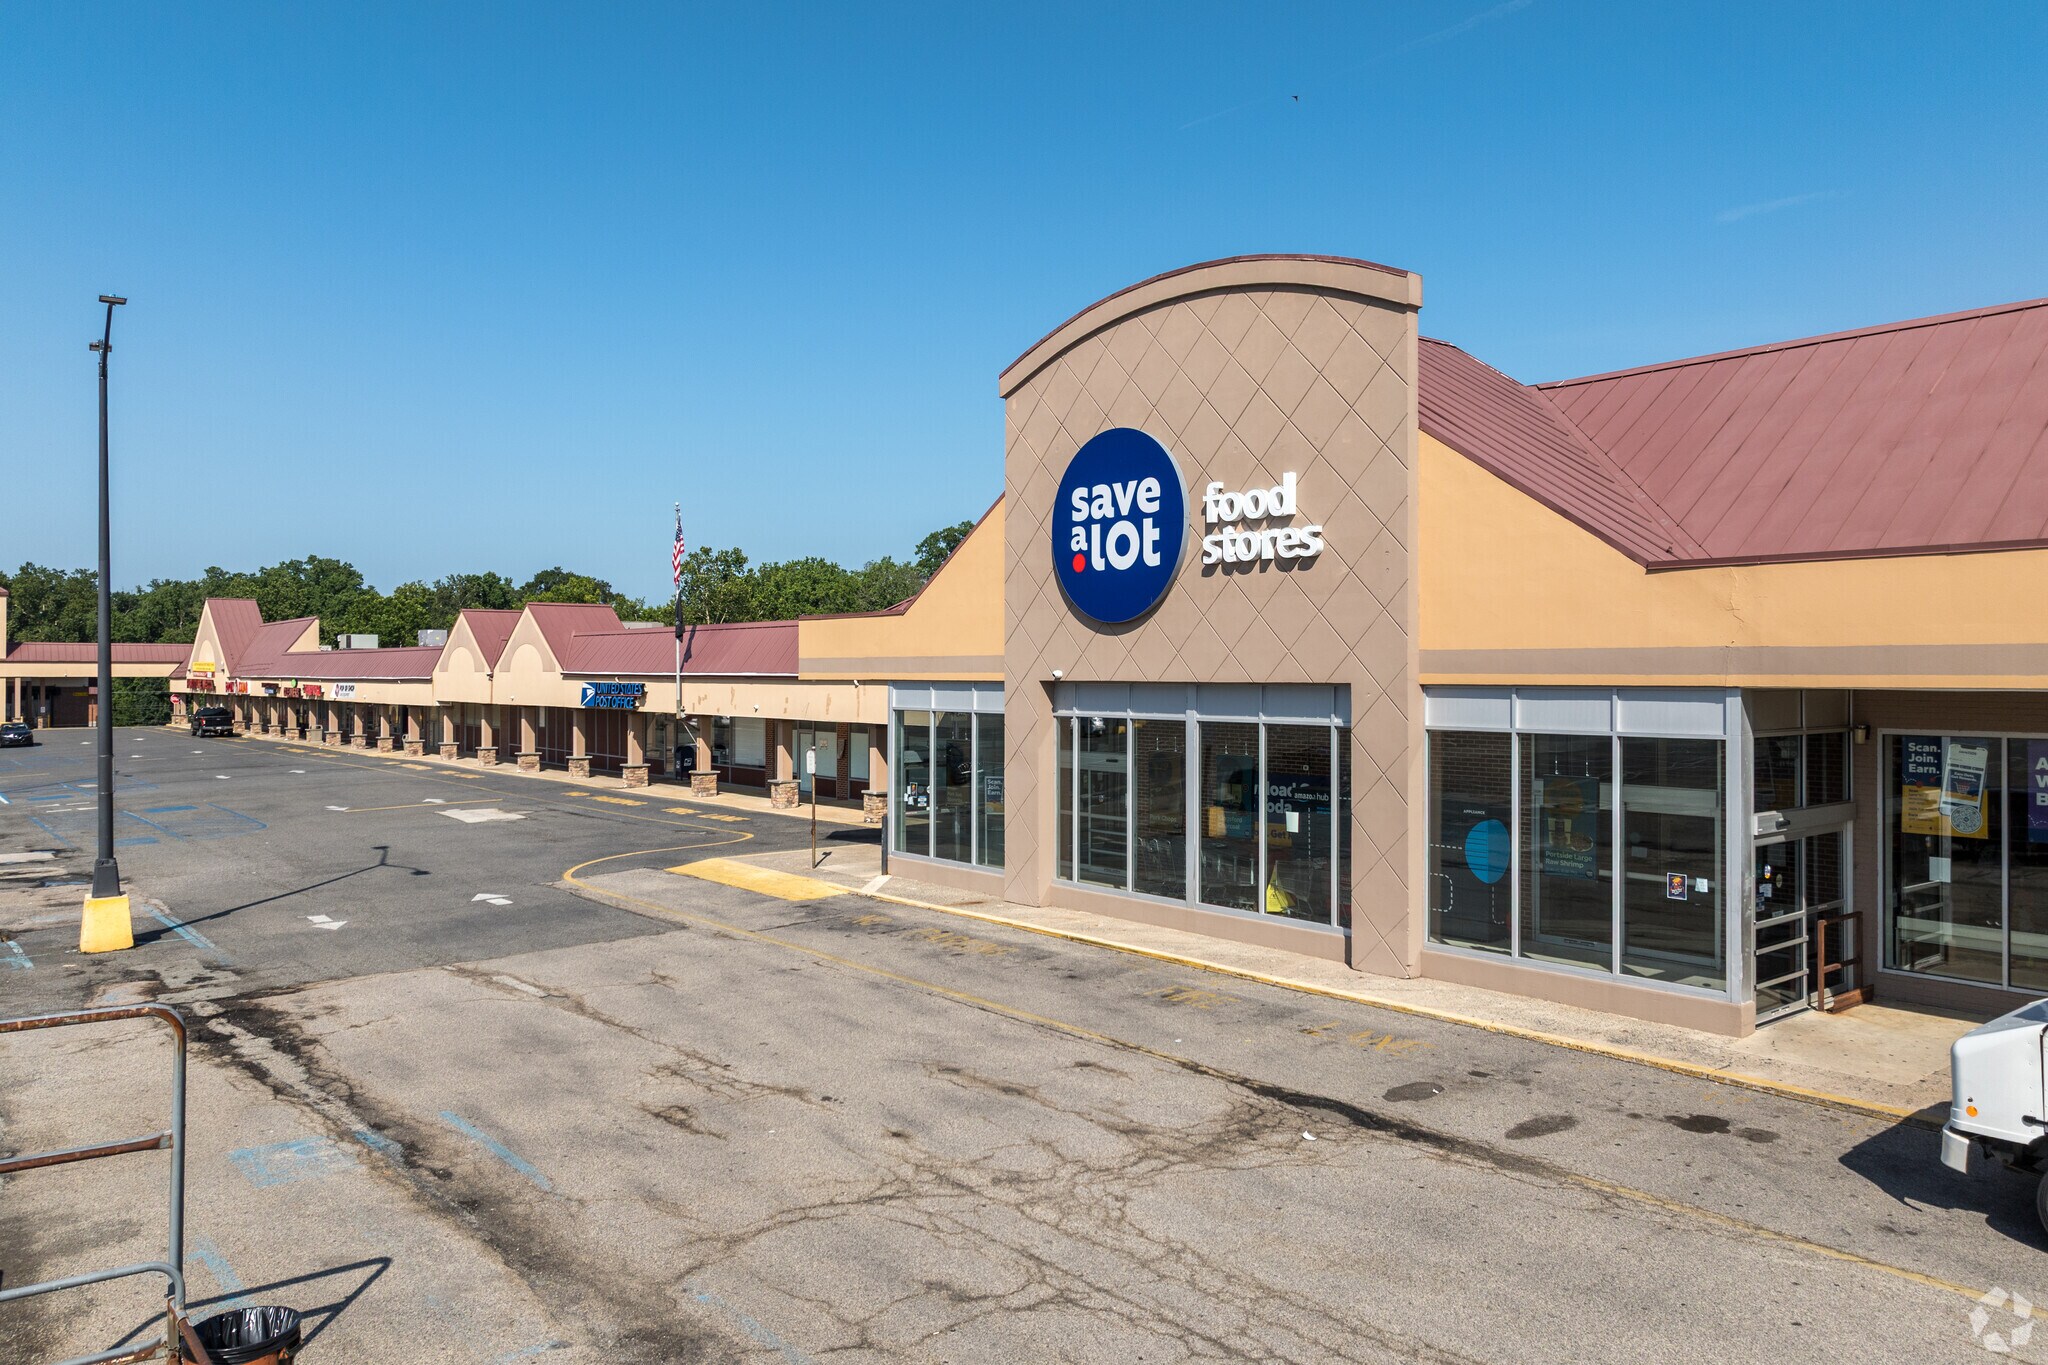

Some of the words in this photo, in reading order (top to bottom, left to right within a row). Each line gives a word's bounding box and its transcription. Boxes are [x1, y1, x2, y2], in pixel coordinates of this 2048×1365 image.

[1071, 477, 1161, 522] save
[1203, 471, 1297, 523] food
[1071, 525, 1088, 552] a
[1202, 525, 1324, 565] stores
[596, 682, 620, 694] UNITED
[620, 683, 642, 695] STATES
[595, 695, 612, 707] POST
[612, 696, 634, 709] OFFICE
[1908, 742, 1941, 753] Scan.
[1908, 753, 1938, 764] Join.
[1908, 763, 1940, 774] Earn.
[1316, 793, 1329, 802] hub
[1545, 850, 1573, 859] Portside
[1573, 854, 1593, 863] Large
[1560, 859, 1585, 869] Shrimp
